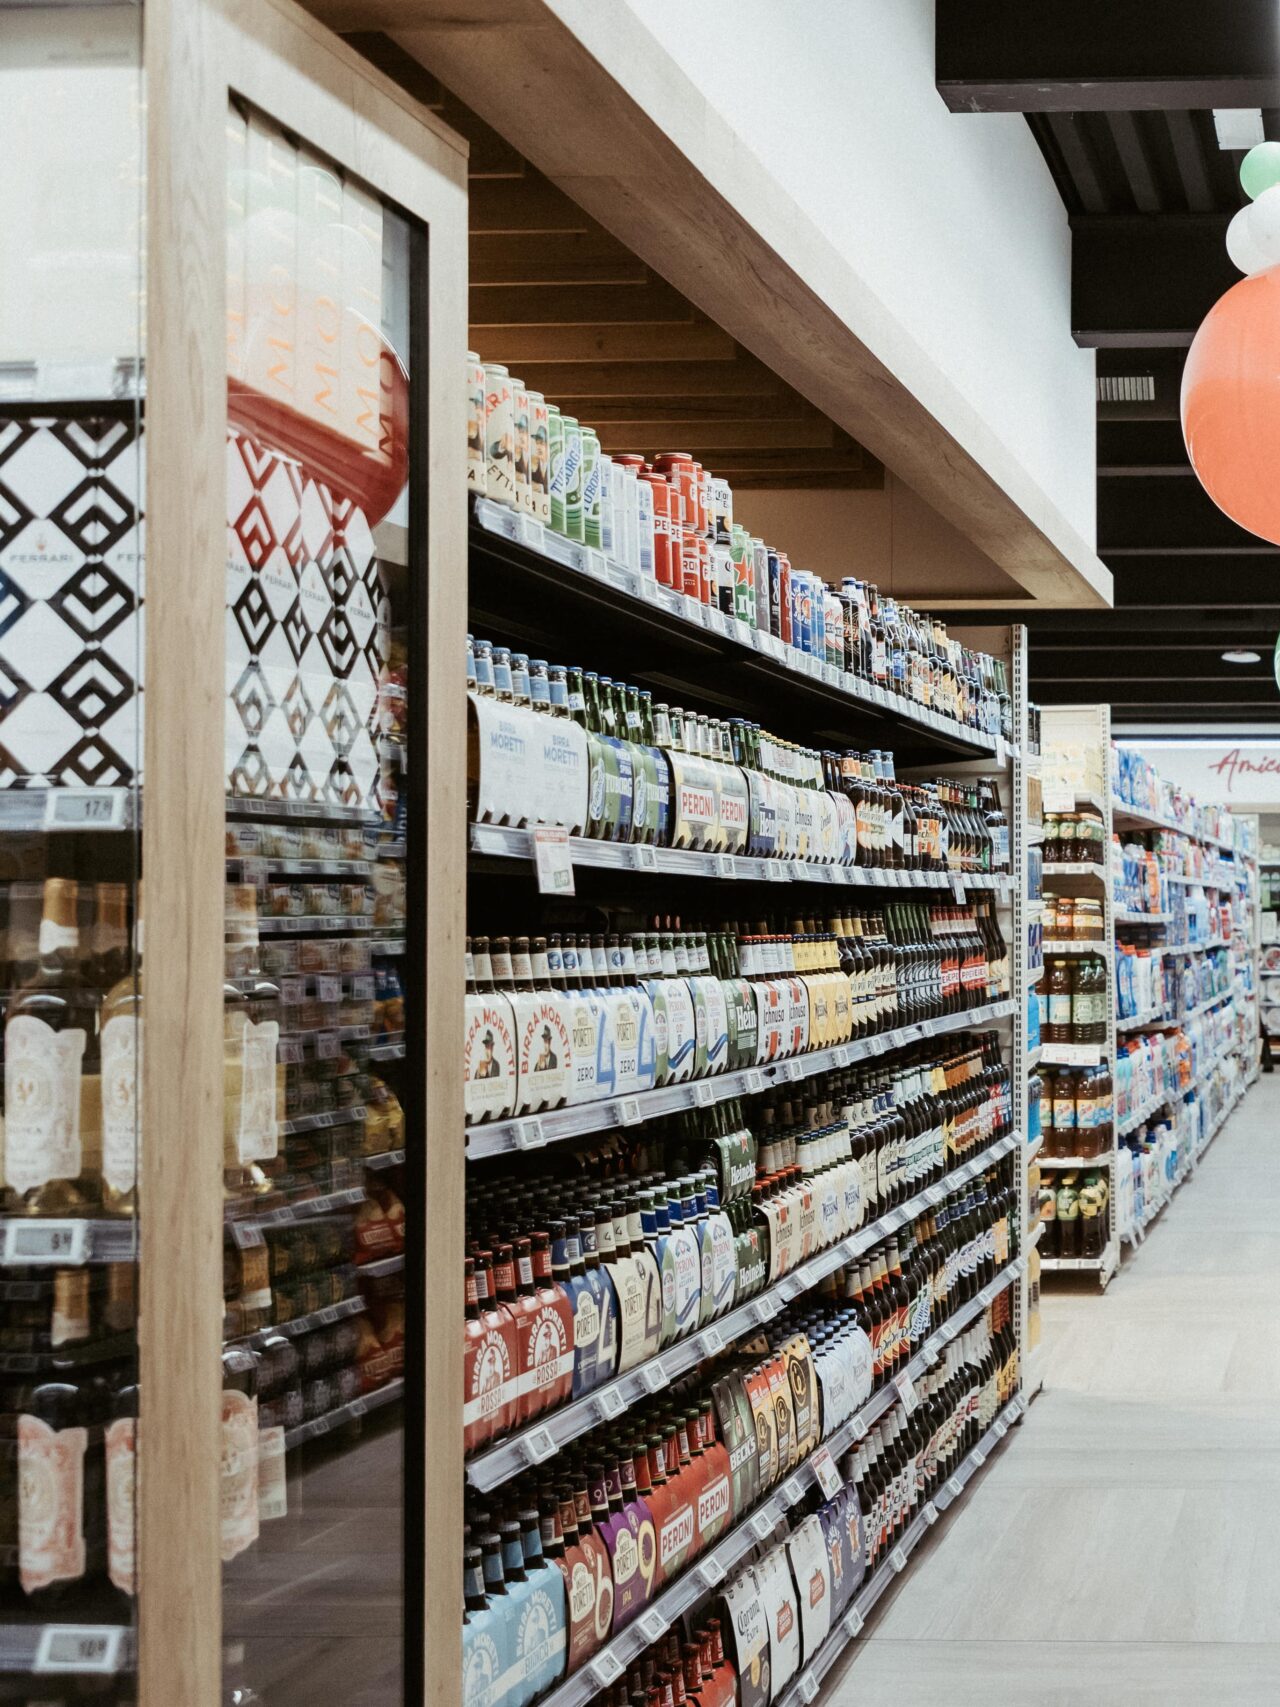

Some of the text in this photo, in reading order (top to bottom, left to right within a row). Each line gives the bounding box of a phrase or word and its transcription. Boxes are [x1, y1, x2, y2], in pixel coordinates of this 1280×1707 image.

[543, 746, 579, 767] MORETTI
[682, 792, 714, 817] PERONI
[721, 799, 745, 823] PERONI
[577, 1067, 594, 1082] ZERO
[527, 1315, 543, 1367] BIRRA
[541, 1306, 567, 1351] MORETTI
[536, 1361, 559, 1386] ROSSA
[700, 1487, 729, 1524] PERONI
[662, 1517, 693, 1558] PERONI
